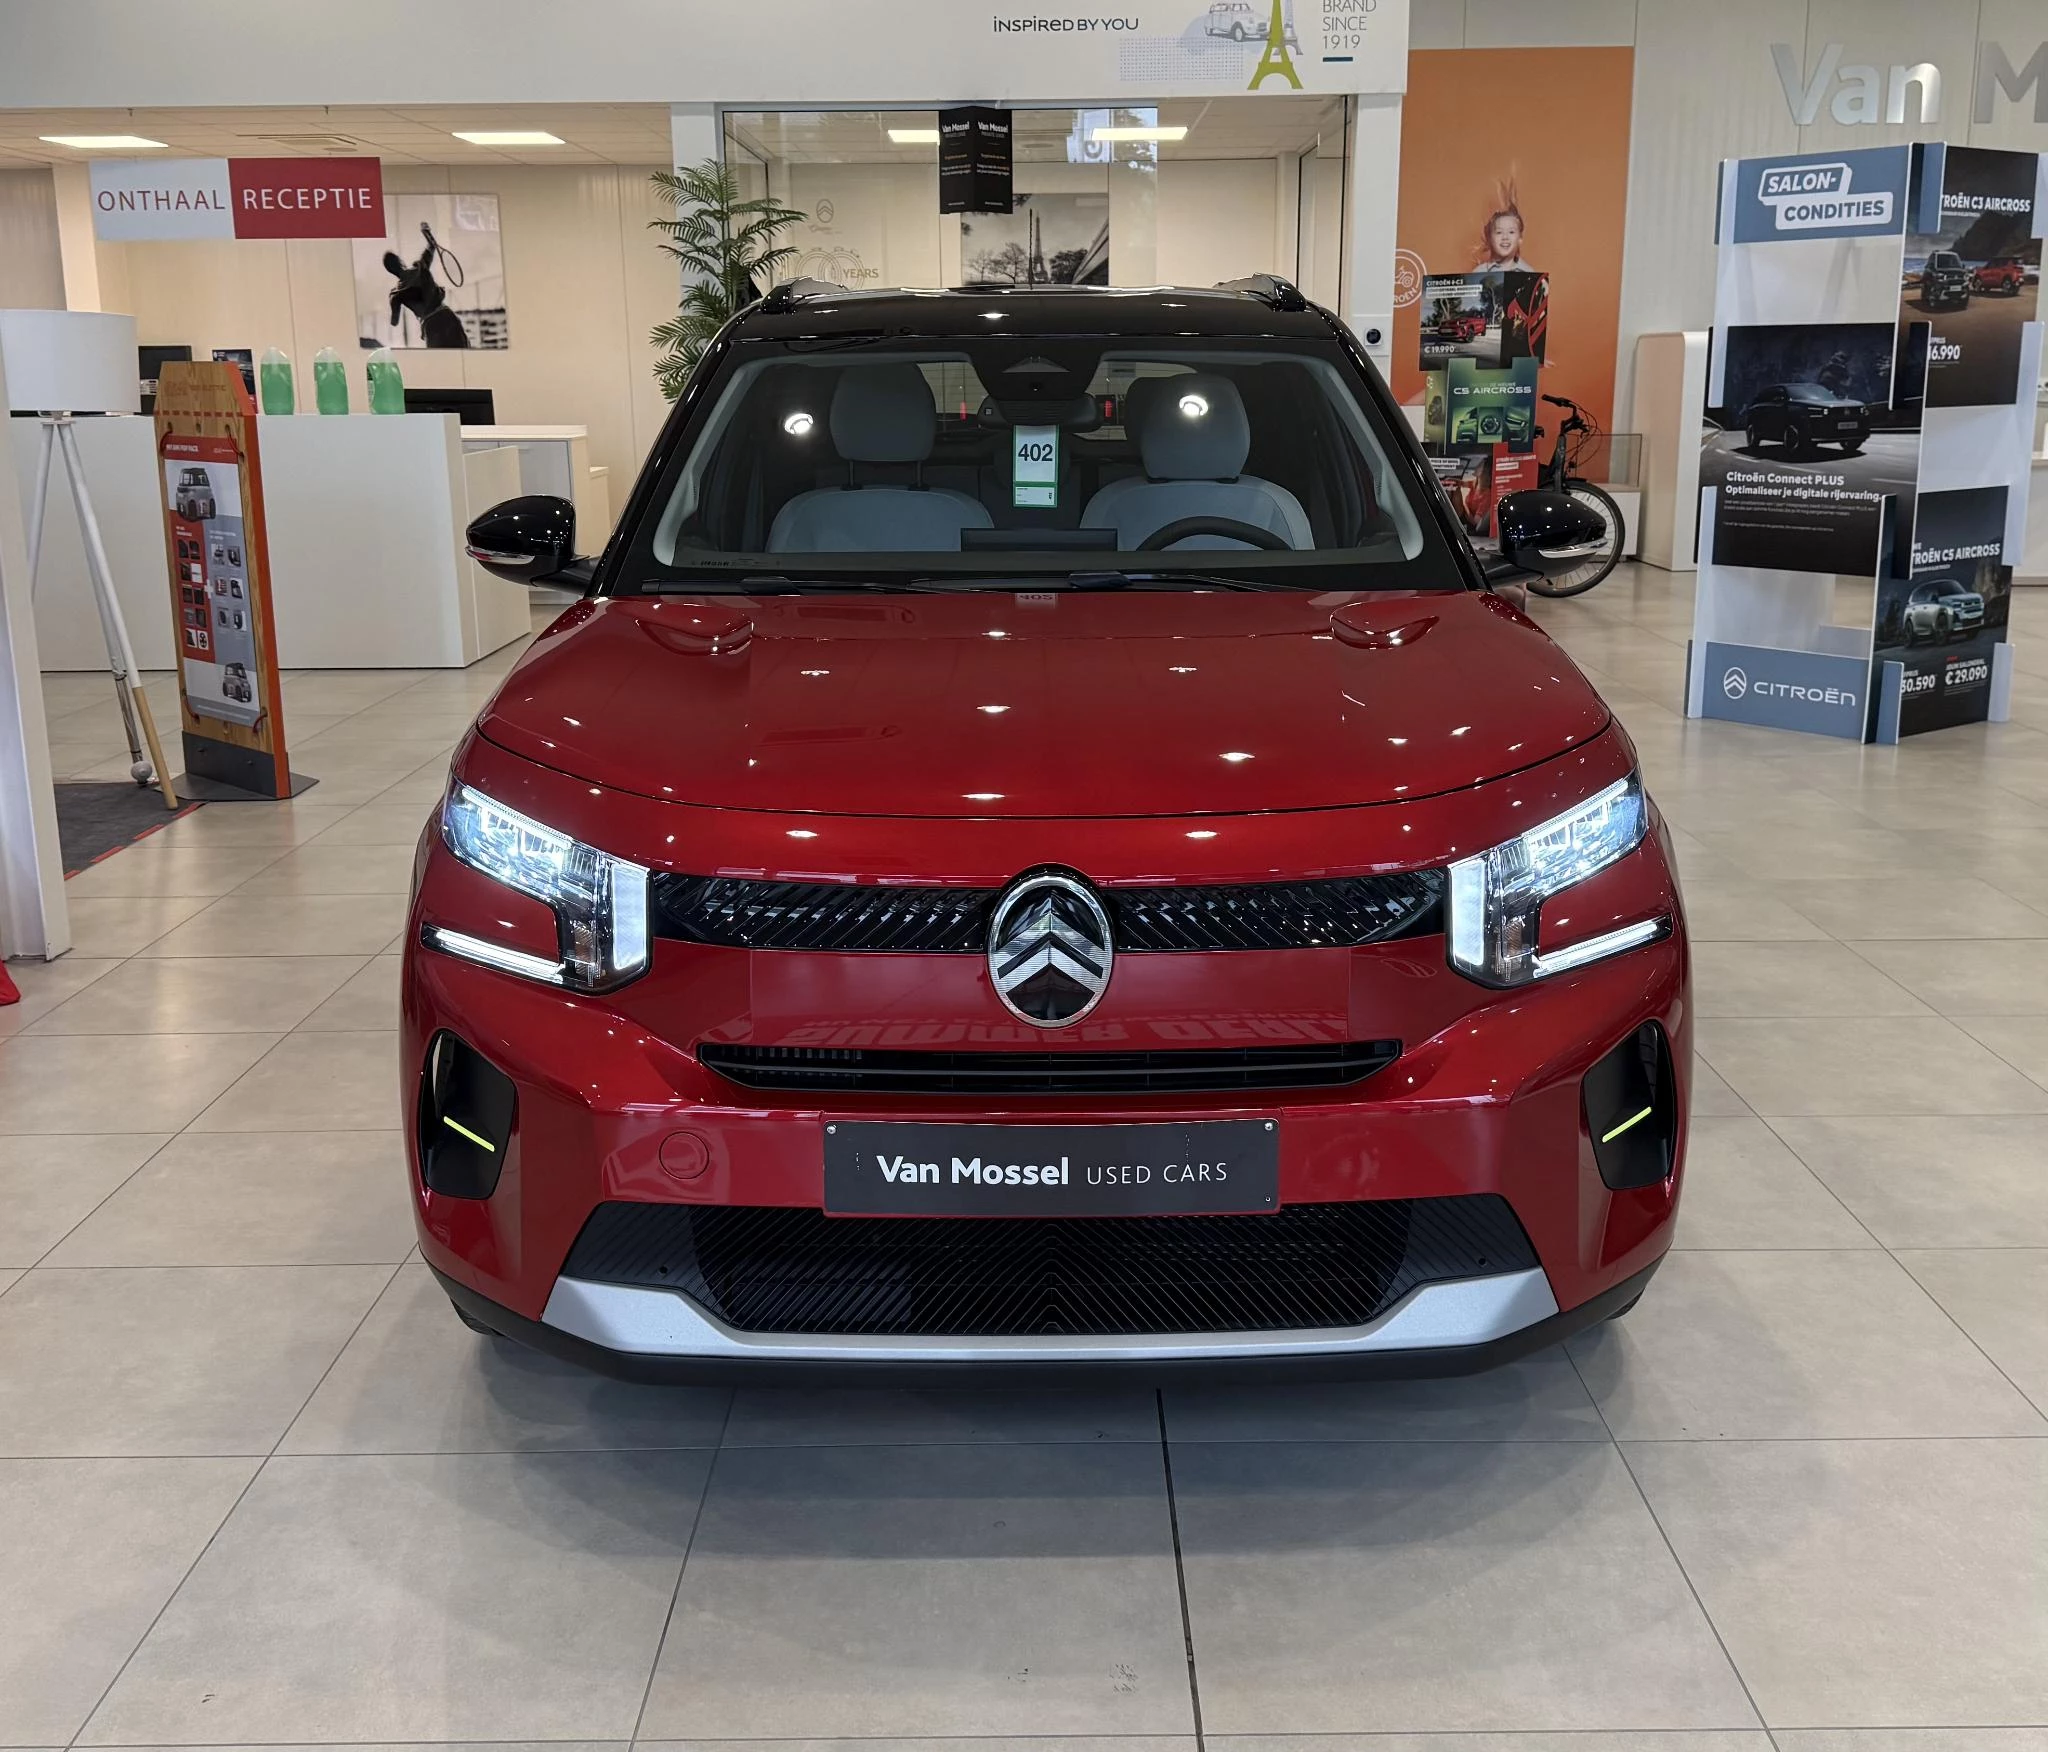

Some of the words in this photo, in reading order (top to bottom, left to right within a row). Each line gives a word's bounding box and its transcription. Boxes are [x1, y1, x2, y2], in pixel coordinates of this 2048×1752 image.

[1323, 0, 1377, 13] BRAND
[1077, 18, 1098, 31] BY
[1101, 18, 1139, 31] YOU
[1322, 16, 1368, 32] SINCE
[1322, 34, 1361, 49] 1919
[1770, 42, 1942, 126] Van
[1768, 170, 1836, 193] SALON-
[97, 189, 226, 211] ONTHAAL
[243, 188, 372, 210] RECEPTIE
[1971, 196, 1983, 210] C3
[1984, 197, 2031, 212] AIRCROSS
[1784, 200, 1885, 222] CONDITIES
[843, 268, 879, 279] YEARS
[1928, 344, 1961, 360] 6.990
[1473, 386, 1532, 395] AIRCROSS
[1018, 443, 1053, 462] 402
[1726, 471, 1765, 483] Citroën
[1767, 473, 1813, 485] Connect
[1815, 475, 1845, 486] PLUS
[1725, 485, 1782, 496] Optimaliseer
[1782, 487, 1792, 498] je
[1793, 487, 1829, 499] digitale
[1830, 490, 1883, 503] rijervaring.
[1955, 543, 2001, 560] AIRCROSS
[1945, 671, 1954, 685] €
[1954, 665, 1988, 684] 29.090
[876, 1155, 940, 1183] Van
[952, 1157, 1069, 1185] Mossel
[1087, 1165, 1151, 1185] USED
[1163, 1162, 1227, 1183] CARS
